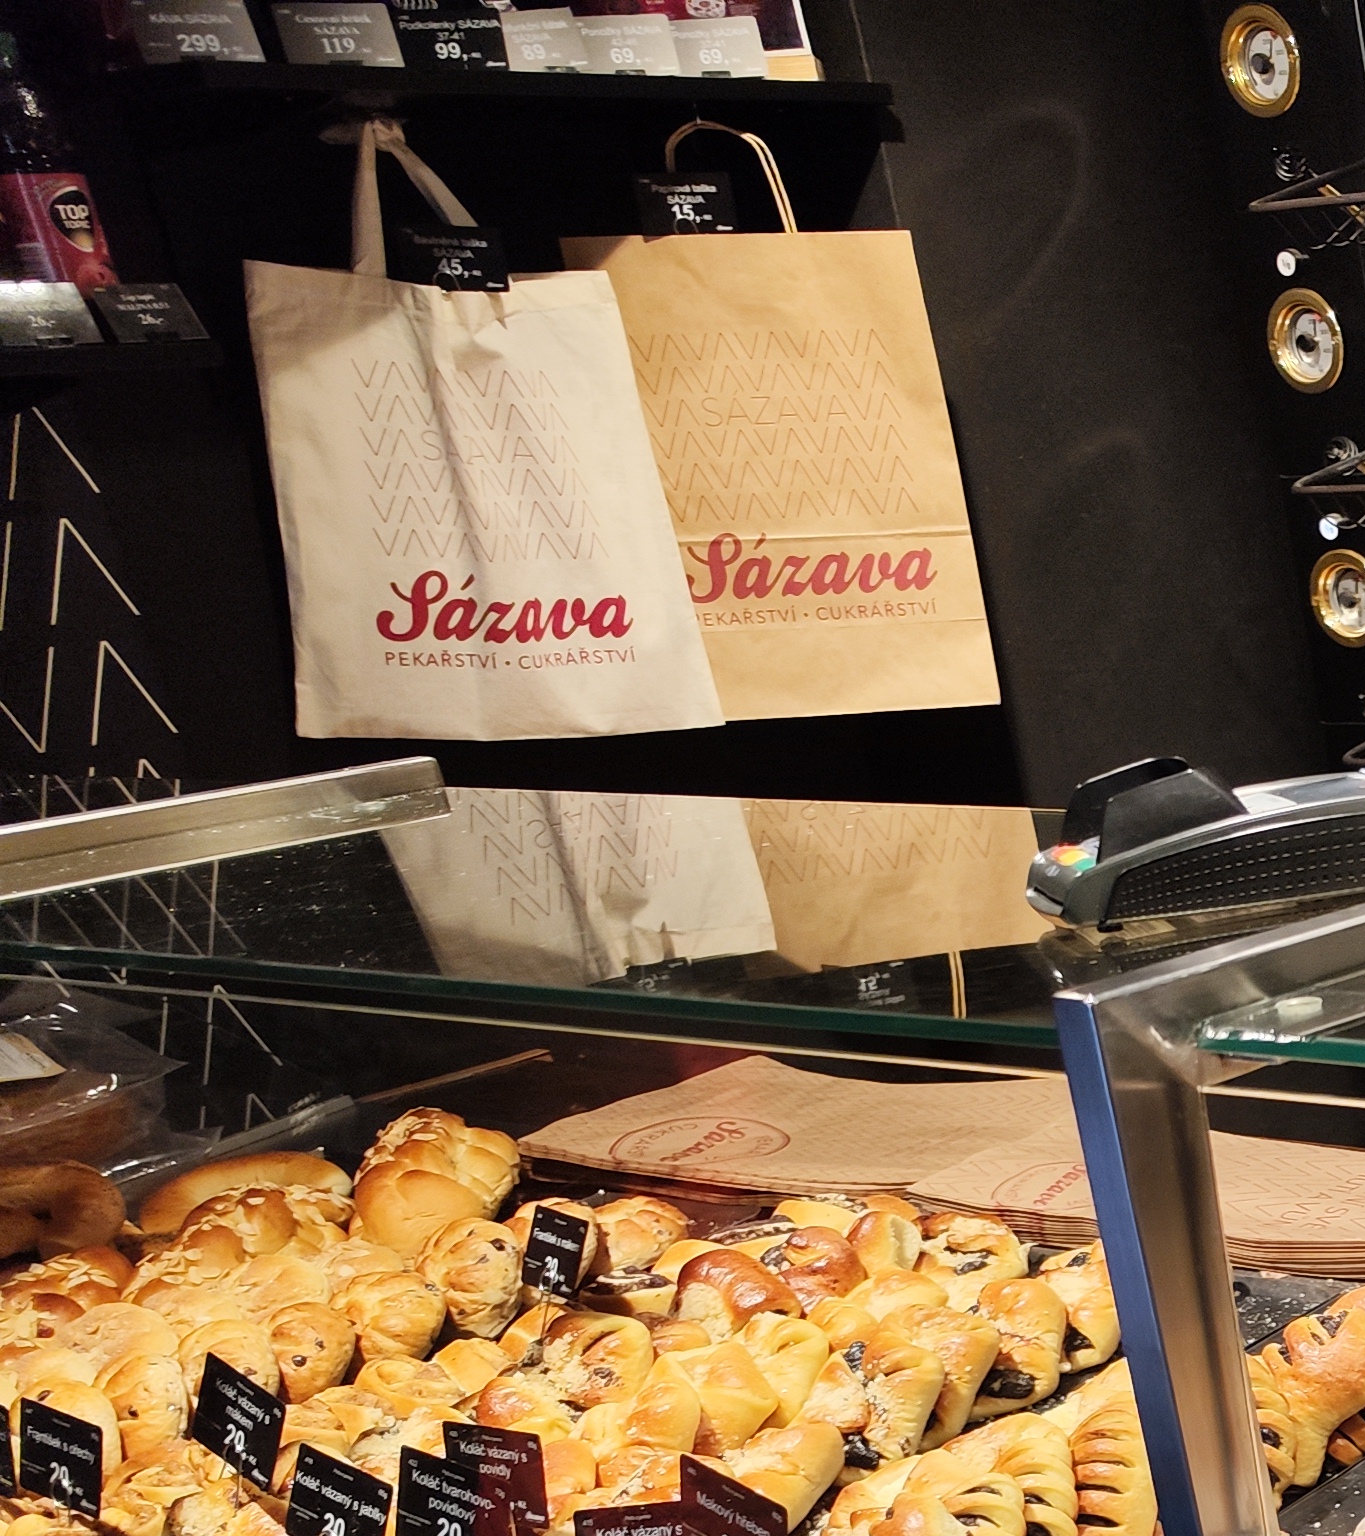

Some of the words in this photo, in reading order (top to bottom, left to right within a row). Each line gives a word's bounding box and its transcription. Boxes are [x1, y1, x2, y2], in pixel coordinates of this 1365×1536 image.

[55, 205, 89, 220] TOP
[687, 532, 937, 604] Sázava
[376, 569, 634, 645] Sázava
[695, 606, 797, 627] EKAŘSTVÍ
[817, 597, 936, 623] CUKRÁŘSTVÍ
[385, 648, 498, 670] PEKAŘSTVÍ
[518, 645, 636, 670] CUKRÁŘSTVÍ
[459, 1440, 486, 1457] Koláč
[487, 1446, 519, 1463] vázaný
[479, 1462, 512, 1481] povidly
[295, 1470, 320, 1493] Koláč
[320, 1483, 352, 1510] vázaný
[358, 1500, 387, 1526] jablky
[412, 1468, 440, 1491] Koláč
[441, 1480, 496, 1511] tvarohovo-
[428, 1496, 476, 1525] povidlový
[696, 1491, 734, 1525] Makový
